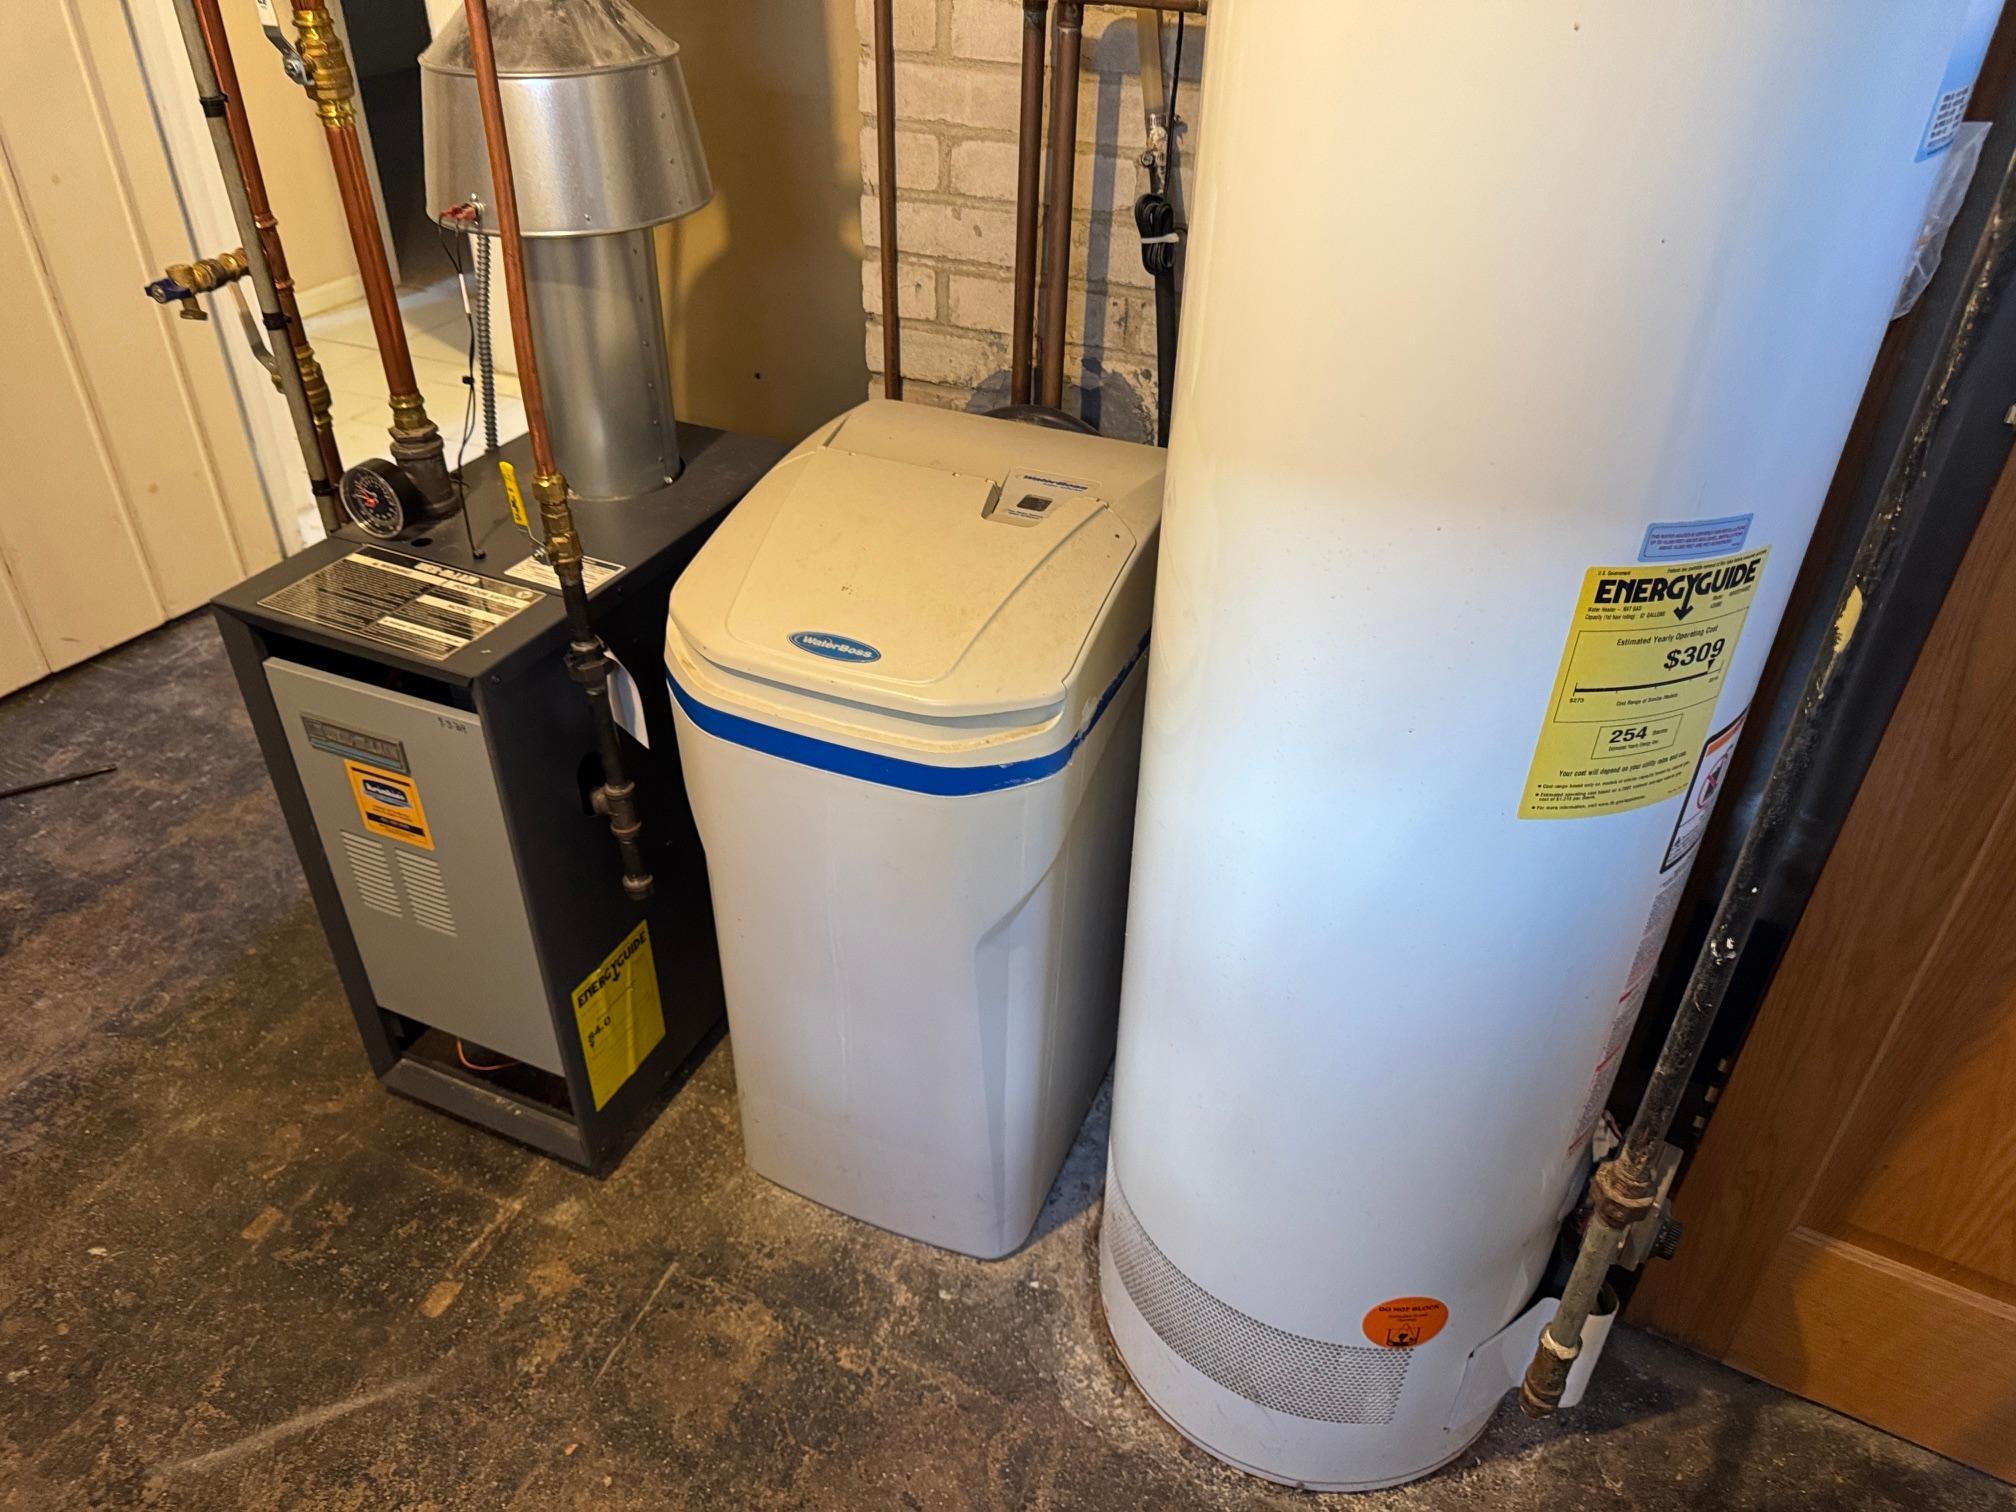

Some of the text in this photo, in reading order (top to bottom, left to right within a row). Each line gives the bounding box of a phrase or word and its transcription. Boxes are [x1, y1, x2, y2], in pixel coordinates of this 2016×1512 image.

[1594, 558, 1761, 606] ENERGYGUIDE
[802, 635, 873, 658] WaterBoss
[1616, 625, 1719, 646] Estimated Yearly Operating Cost
[1664, 638, 1725, 671] $309
[1609, 726, 1648, 744] 254
[1588, 768, 1600, 776] will
[1600, 766, 1621, 775] depend
[577, 930, 646, 1008] ENERGYGUIDE
